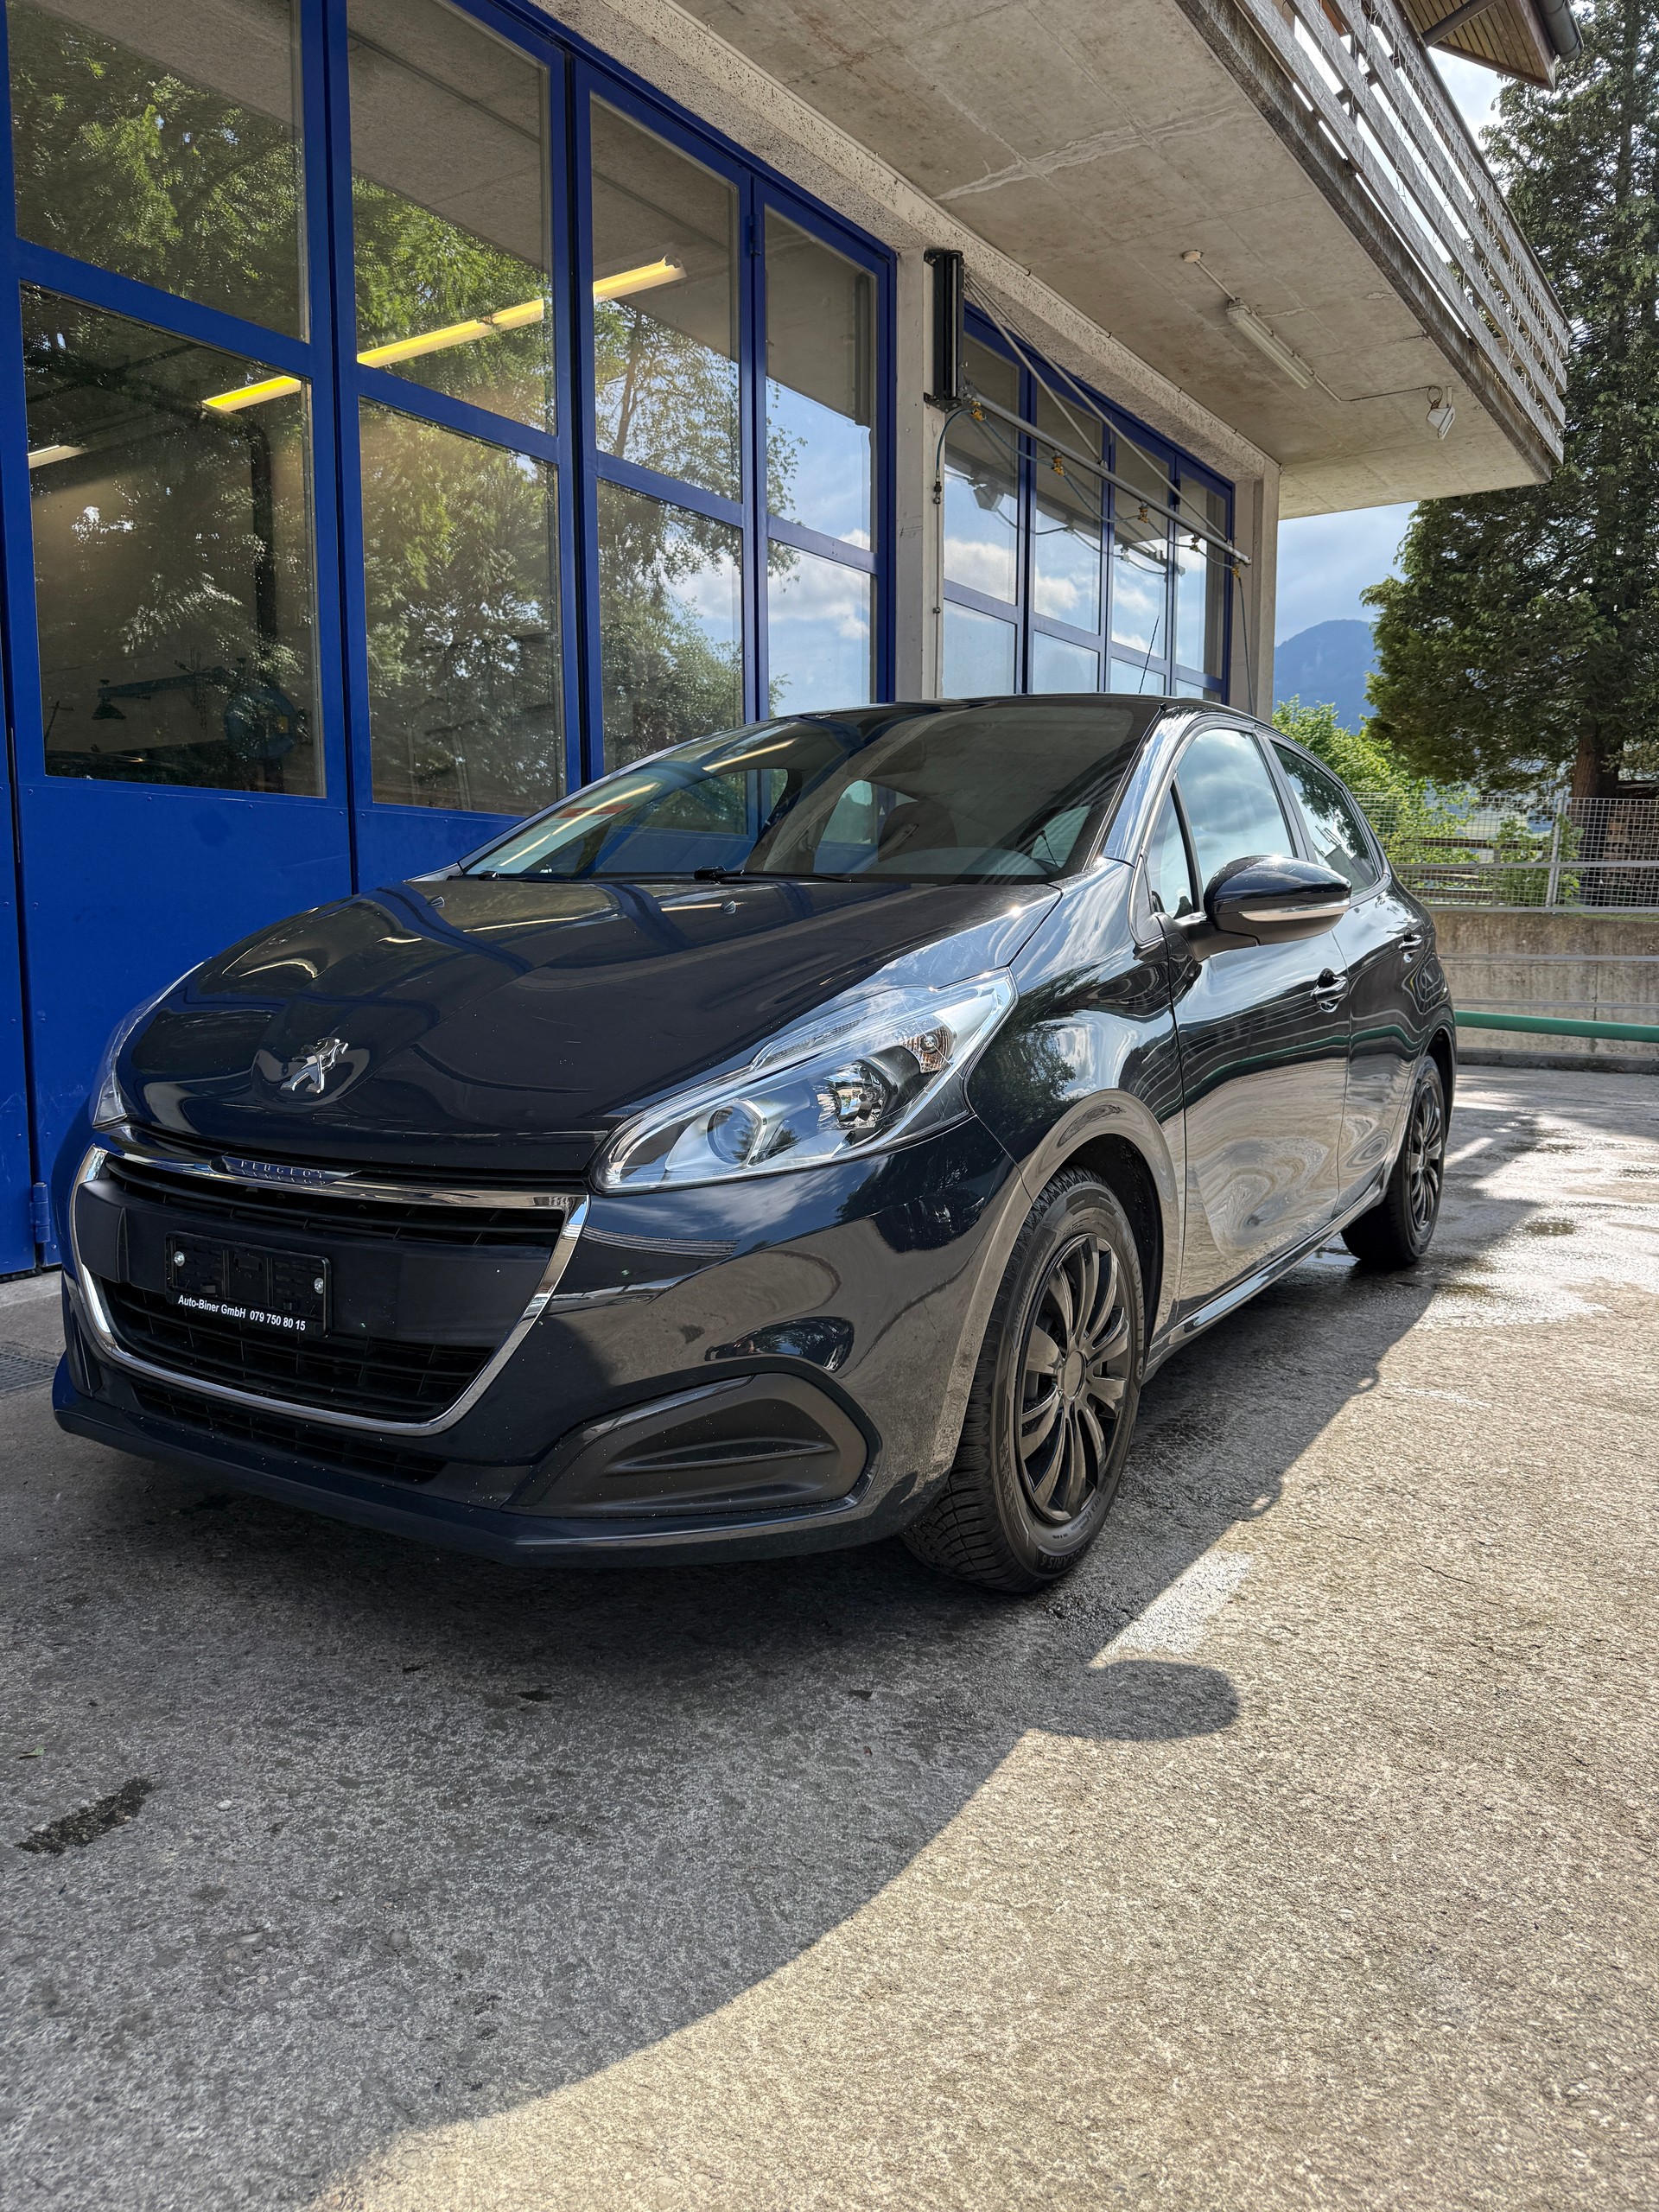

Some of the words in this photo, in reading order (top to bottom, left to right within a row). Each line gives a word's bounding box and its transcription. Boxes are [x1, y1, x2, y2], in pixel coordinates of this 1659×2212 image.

[241, 1160, 326, 1179] PEUGEOT
[178, 1295, 219, 1313] Auto-Biner
[221, 1304, 246, 1319] GmbH
[250, 1310, 264, 1322] 079
[266, 1313, 282, 1326] 750
[283, 1317, 293, 1329] 80
[296, 1320, 306, 1332] 15
[1040, 1554, 1047, 1567] 6
[1047, 1545, 1086, 1569] POLARIS
